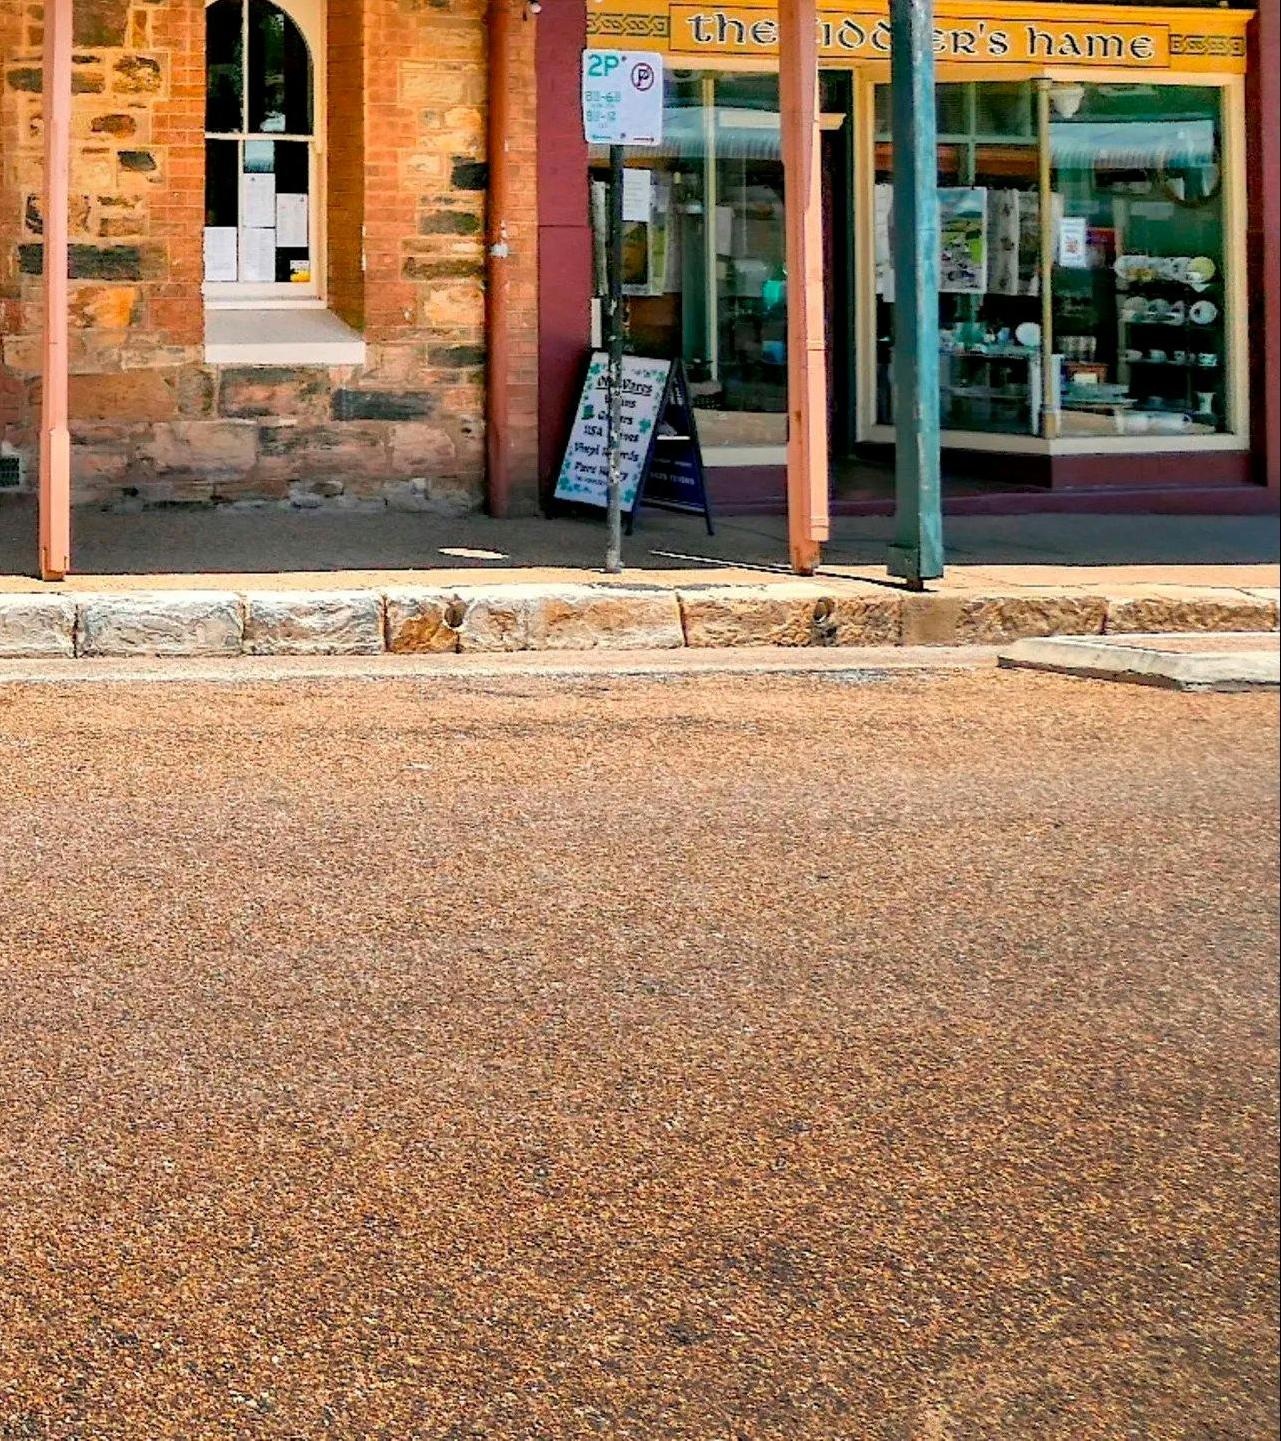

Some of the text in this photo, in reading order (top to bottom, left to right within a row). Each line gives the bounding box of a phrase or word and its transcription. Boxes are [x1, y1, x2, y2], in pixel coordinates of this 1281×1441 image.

[688, 13, 777, 44] the
[1026, 26, 1155, 58] hame
[588, 54, 619, 76] 2P
